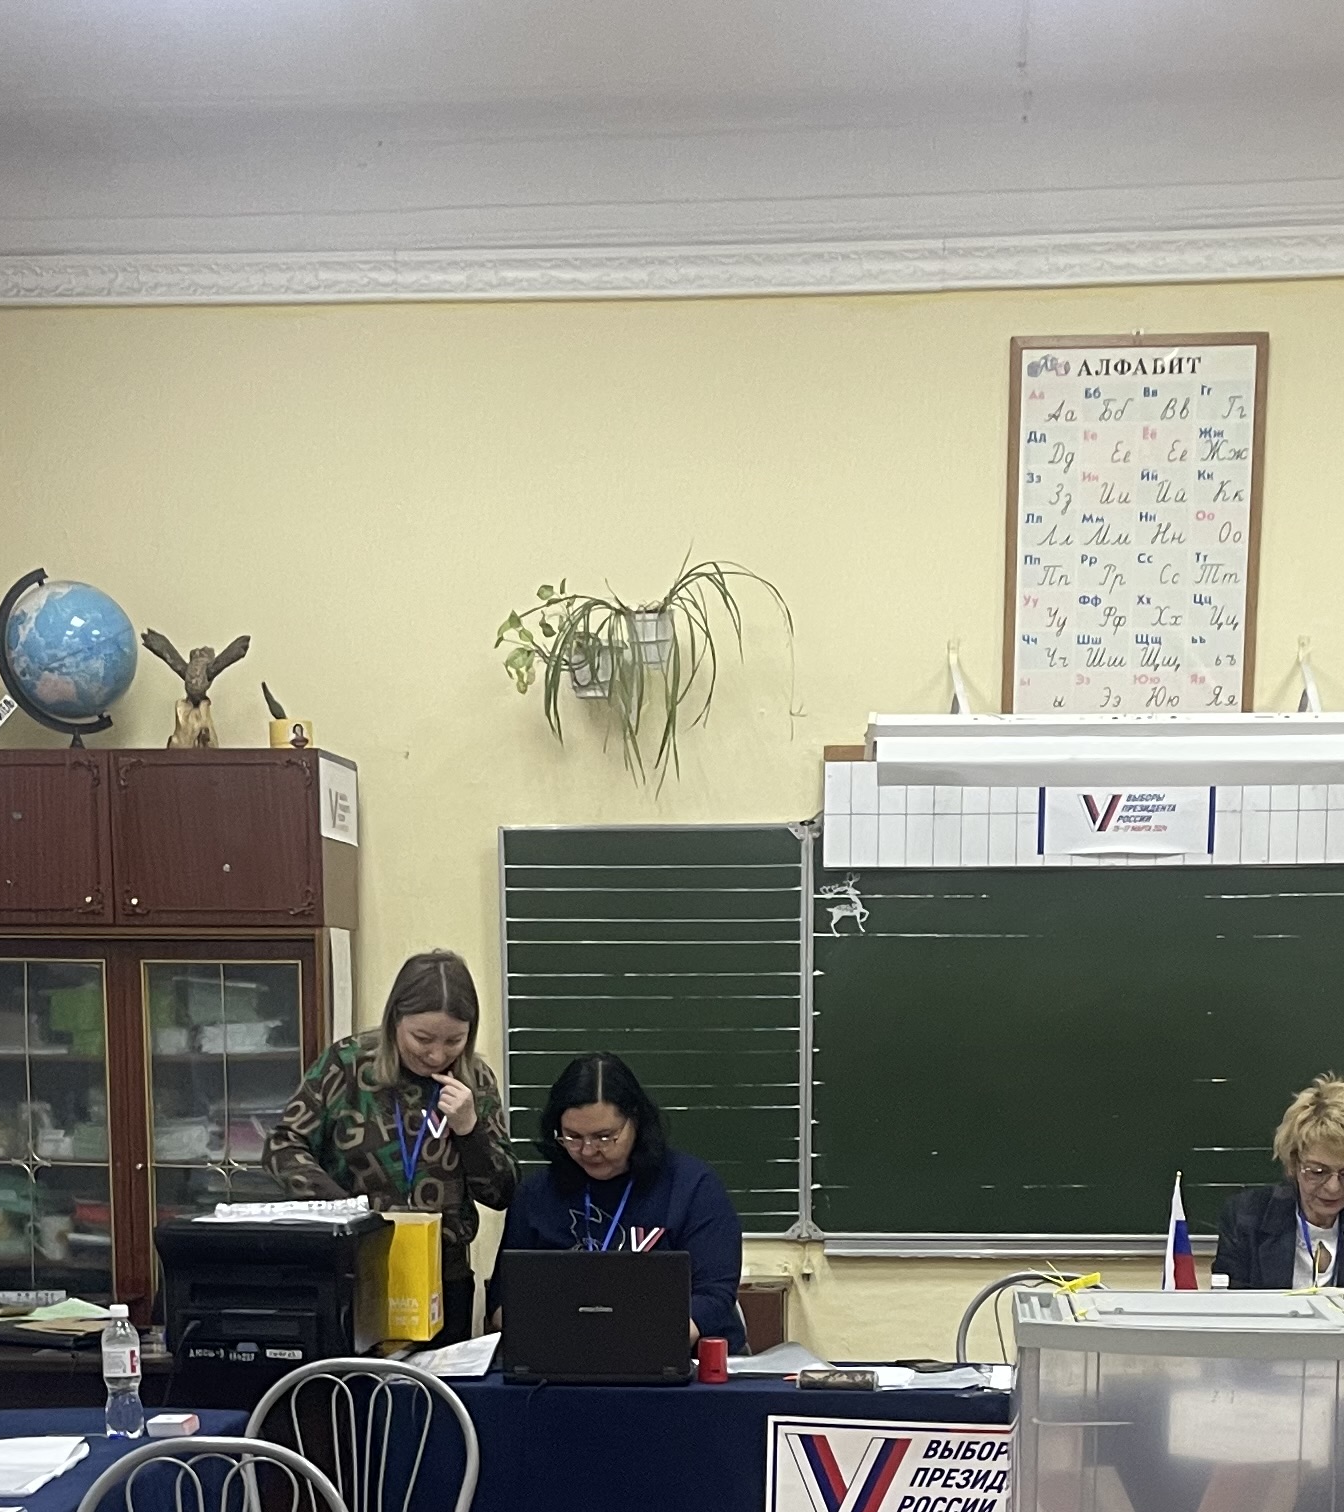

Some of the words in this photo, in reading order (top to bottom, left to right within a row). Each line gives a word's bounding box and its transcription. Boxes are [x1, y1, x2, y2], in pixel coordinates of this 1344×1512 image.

[1125, 793, 1166, 802] ВЫБОРЫ
[1121, 804, 1177, 813] ПРЕЗИДЕНТА
[1116, 815, 1153, 823] РОССИИ
[922, 1439, 1009, 1462] ВЫБОР
[909, 1467, 1008, 1493] ПРЕЗИД
